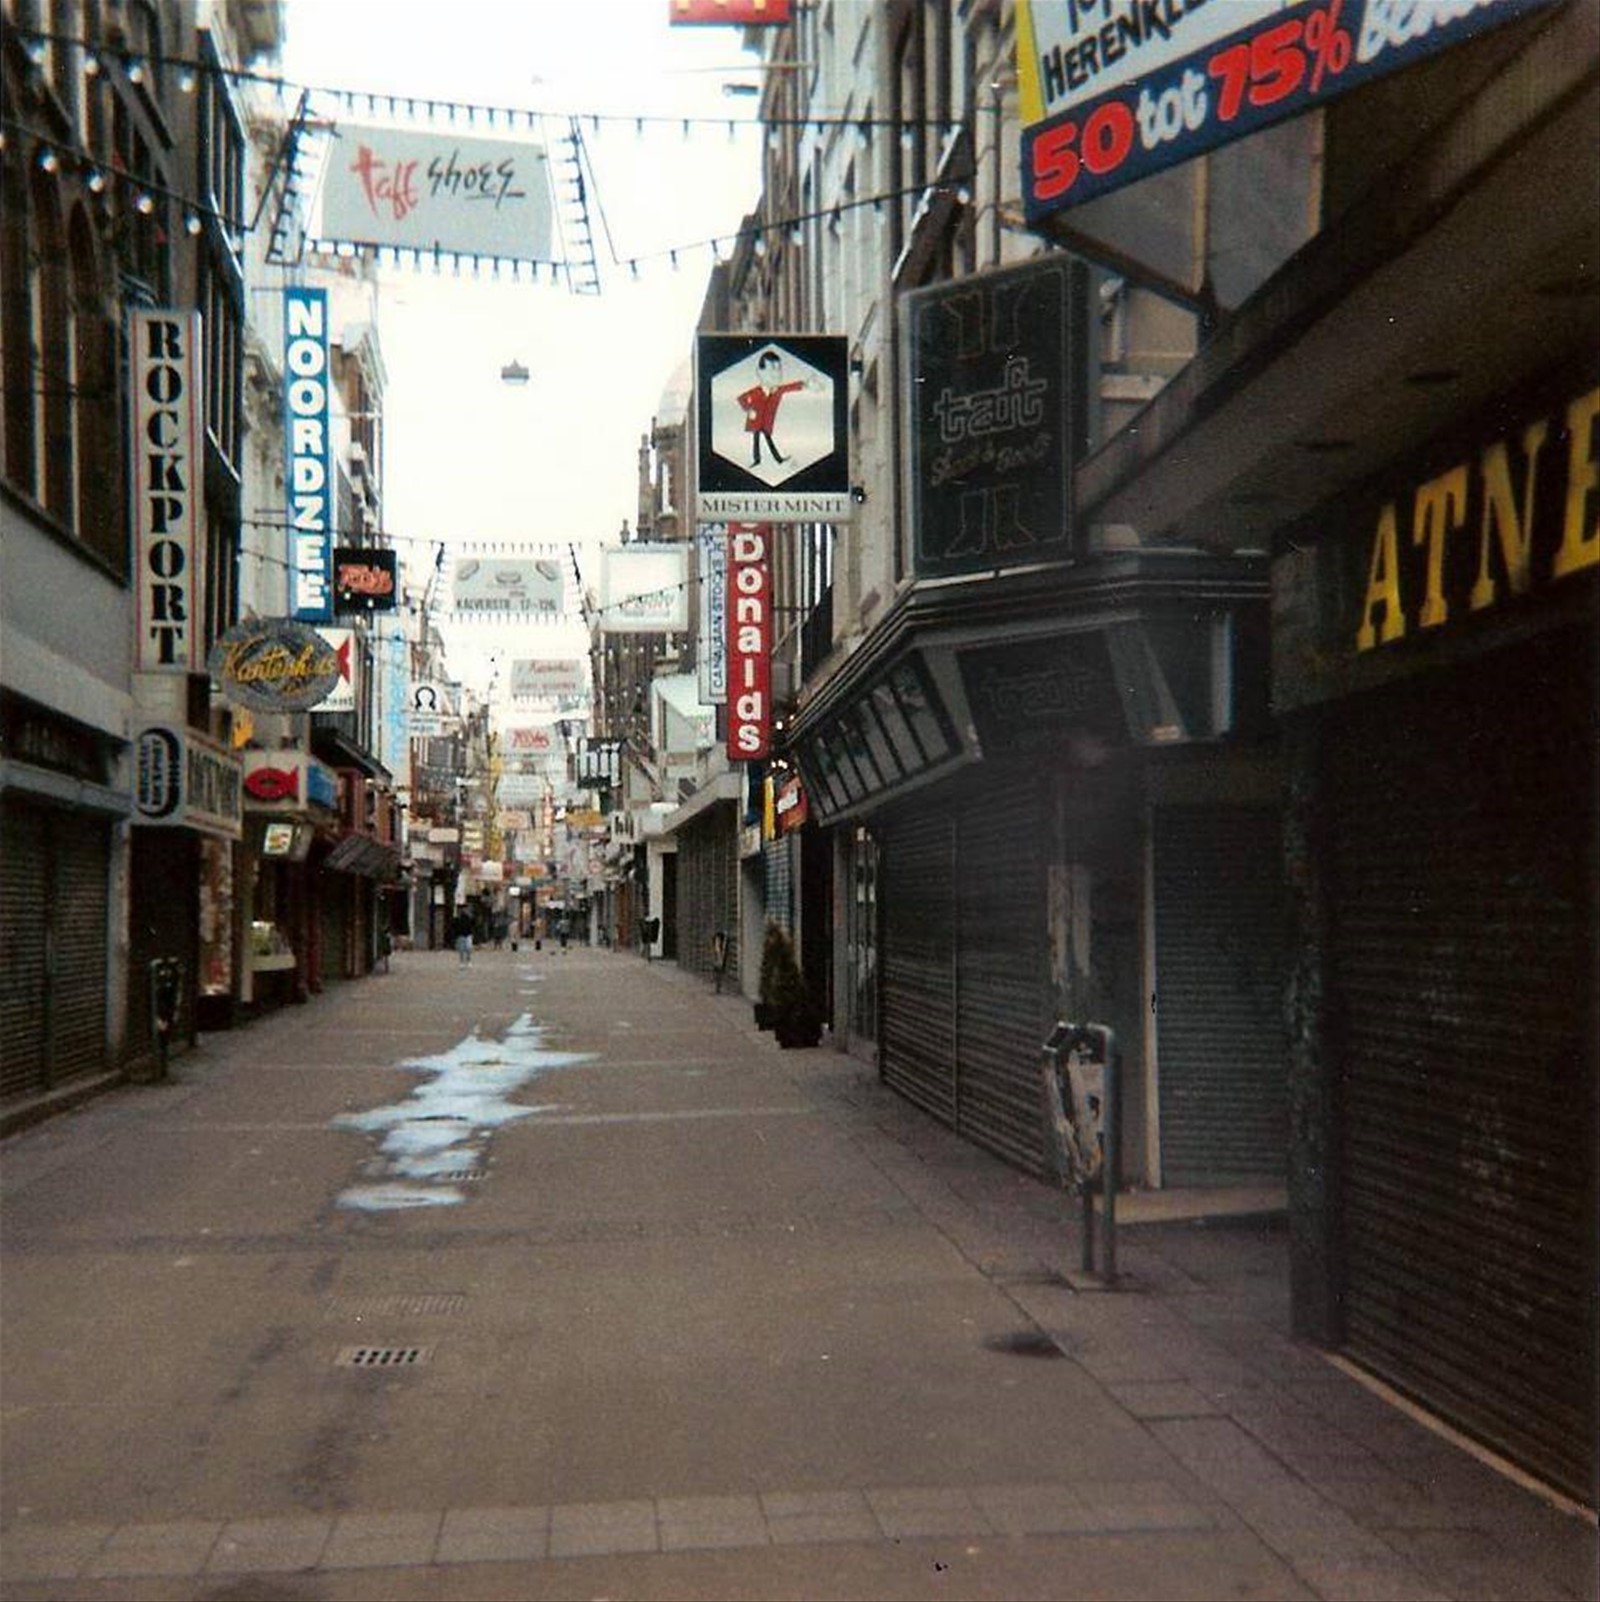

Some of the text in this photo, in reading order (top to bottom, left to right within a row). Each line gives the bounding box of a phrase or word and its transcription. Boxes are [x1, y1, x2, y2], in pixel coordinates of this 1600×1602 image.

[1033, 120, 1133, 200] 50
[1137, 68, 1208, 150] tot
[1208, 0, 1350, 121] 75%
[146, 320, 188, 664] ROCKPORT
[288, 299, 327, 609] NOORDZEE
[702, 499, 844, 512] MISTER MINIT
[712, 615, 724, 688] CANADIAN
